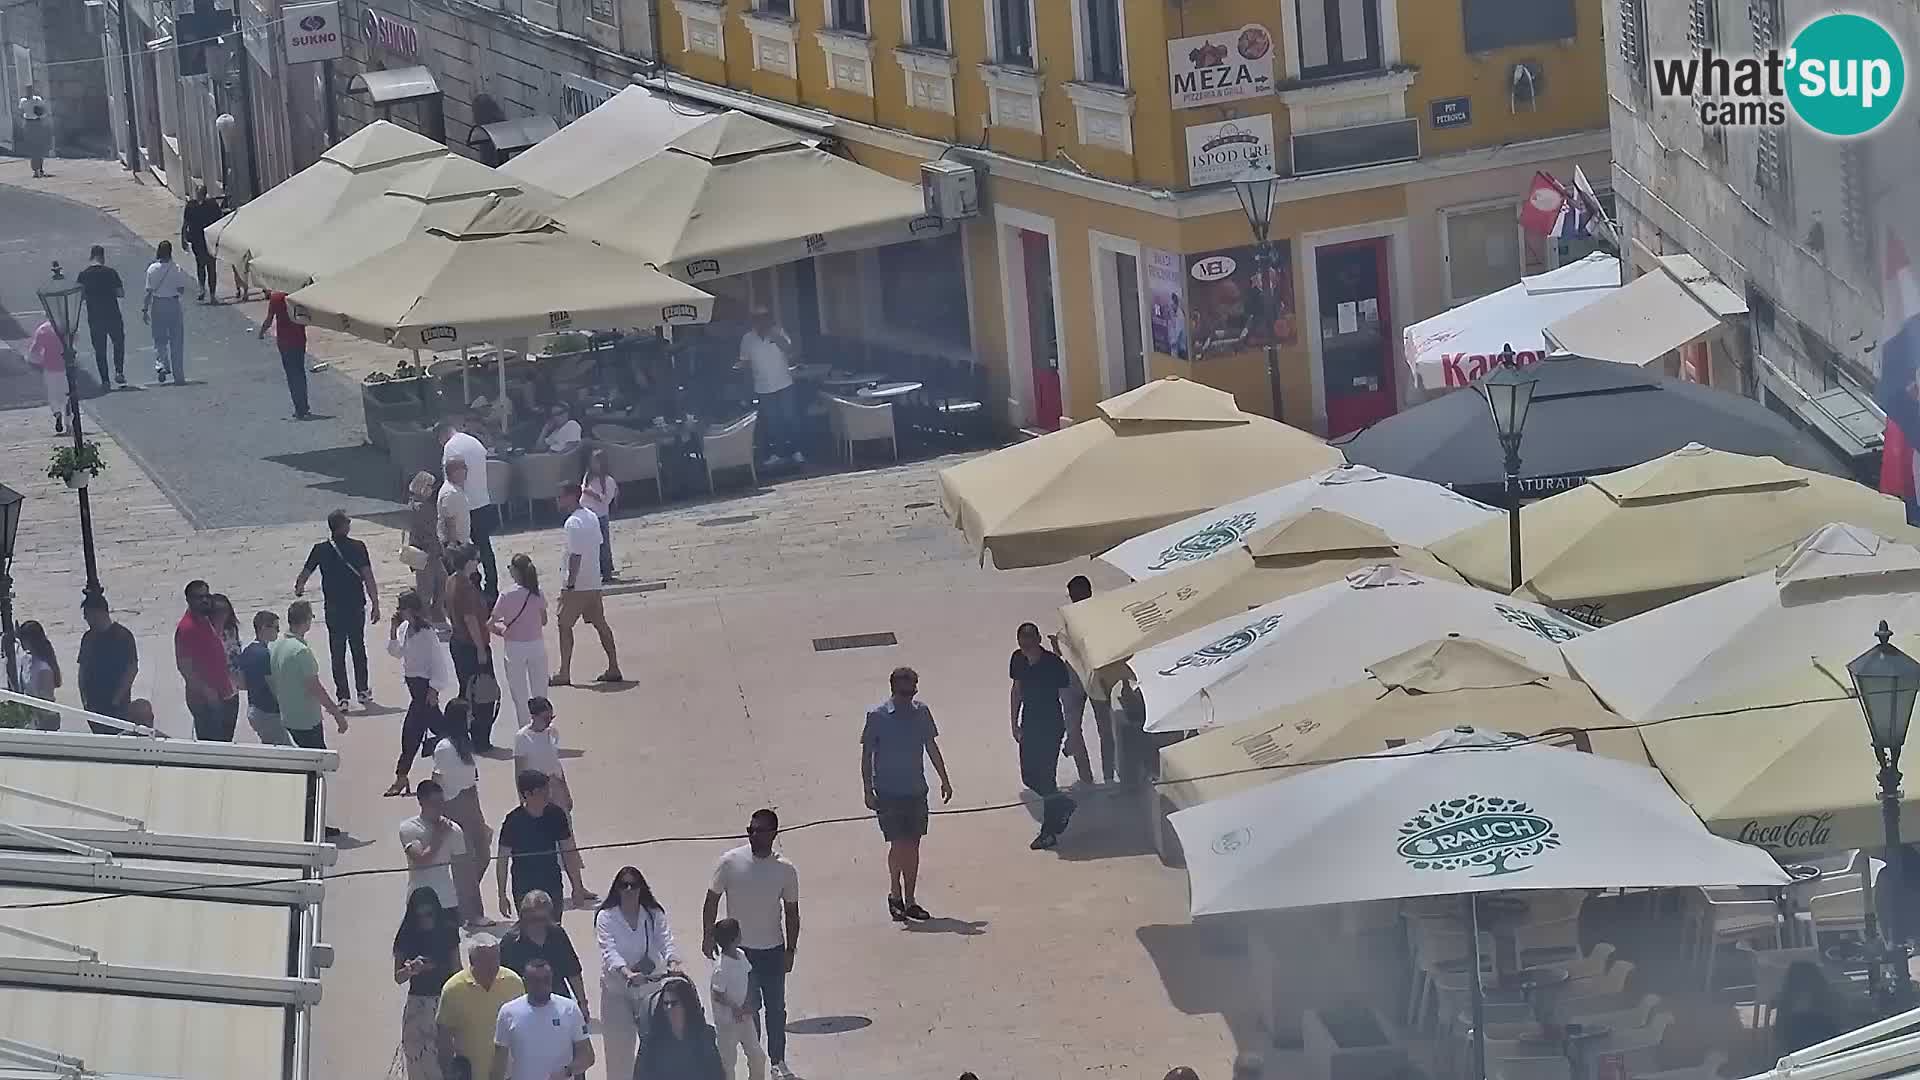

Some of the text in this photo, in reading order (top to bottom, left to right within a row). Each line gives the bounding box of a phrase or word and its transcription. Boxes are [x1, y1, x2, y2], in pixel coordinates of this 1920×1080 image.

[291, 32, 337, 47] SUKNO
[379, 16, 418, 56] SUKNO
[1174, 64, 1253, 94] MEZA
[1192, 149, 1239, 168] ISPOD
[1436, 819, 1536, 851] RAUCH
